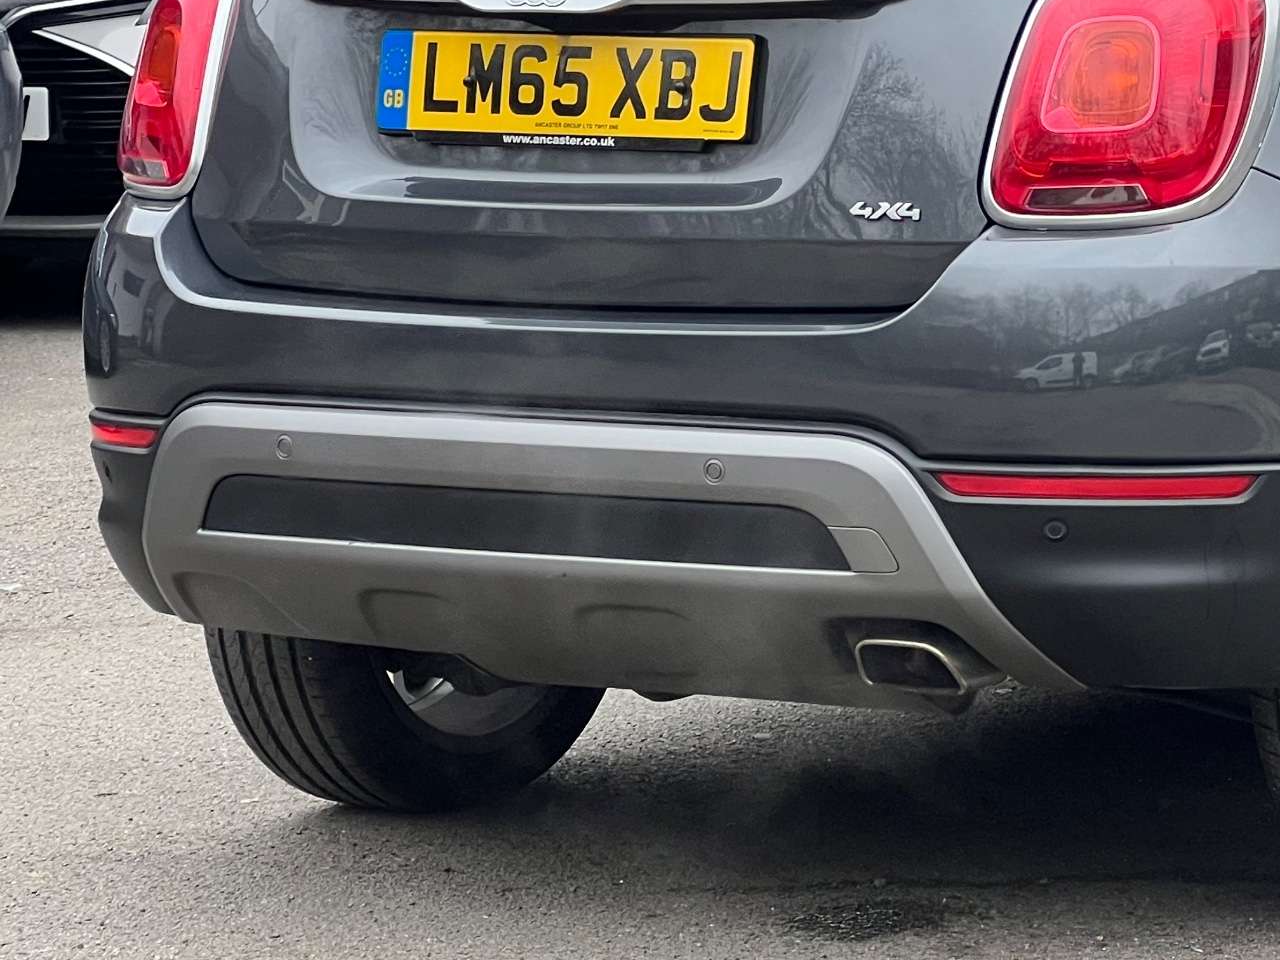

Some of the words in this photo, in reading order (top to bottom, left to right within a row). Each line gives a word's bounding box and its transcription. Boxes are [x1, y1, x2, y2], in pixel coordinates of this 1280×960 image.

[423, 42, 593, 117] LM65
[610, 47, 743, 122] XBJ
[383, 89, 404, 108] GB
[502, 135, 615, 147] www.ancaster.co.uk
